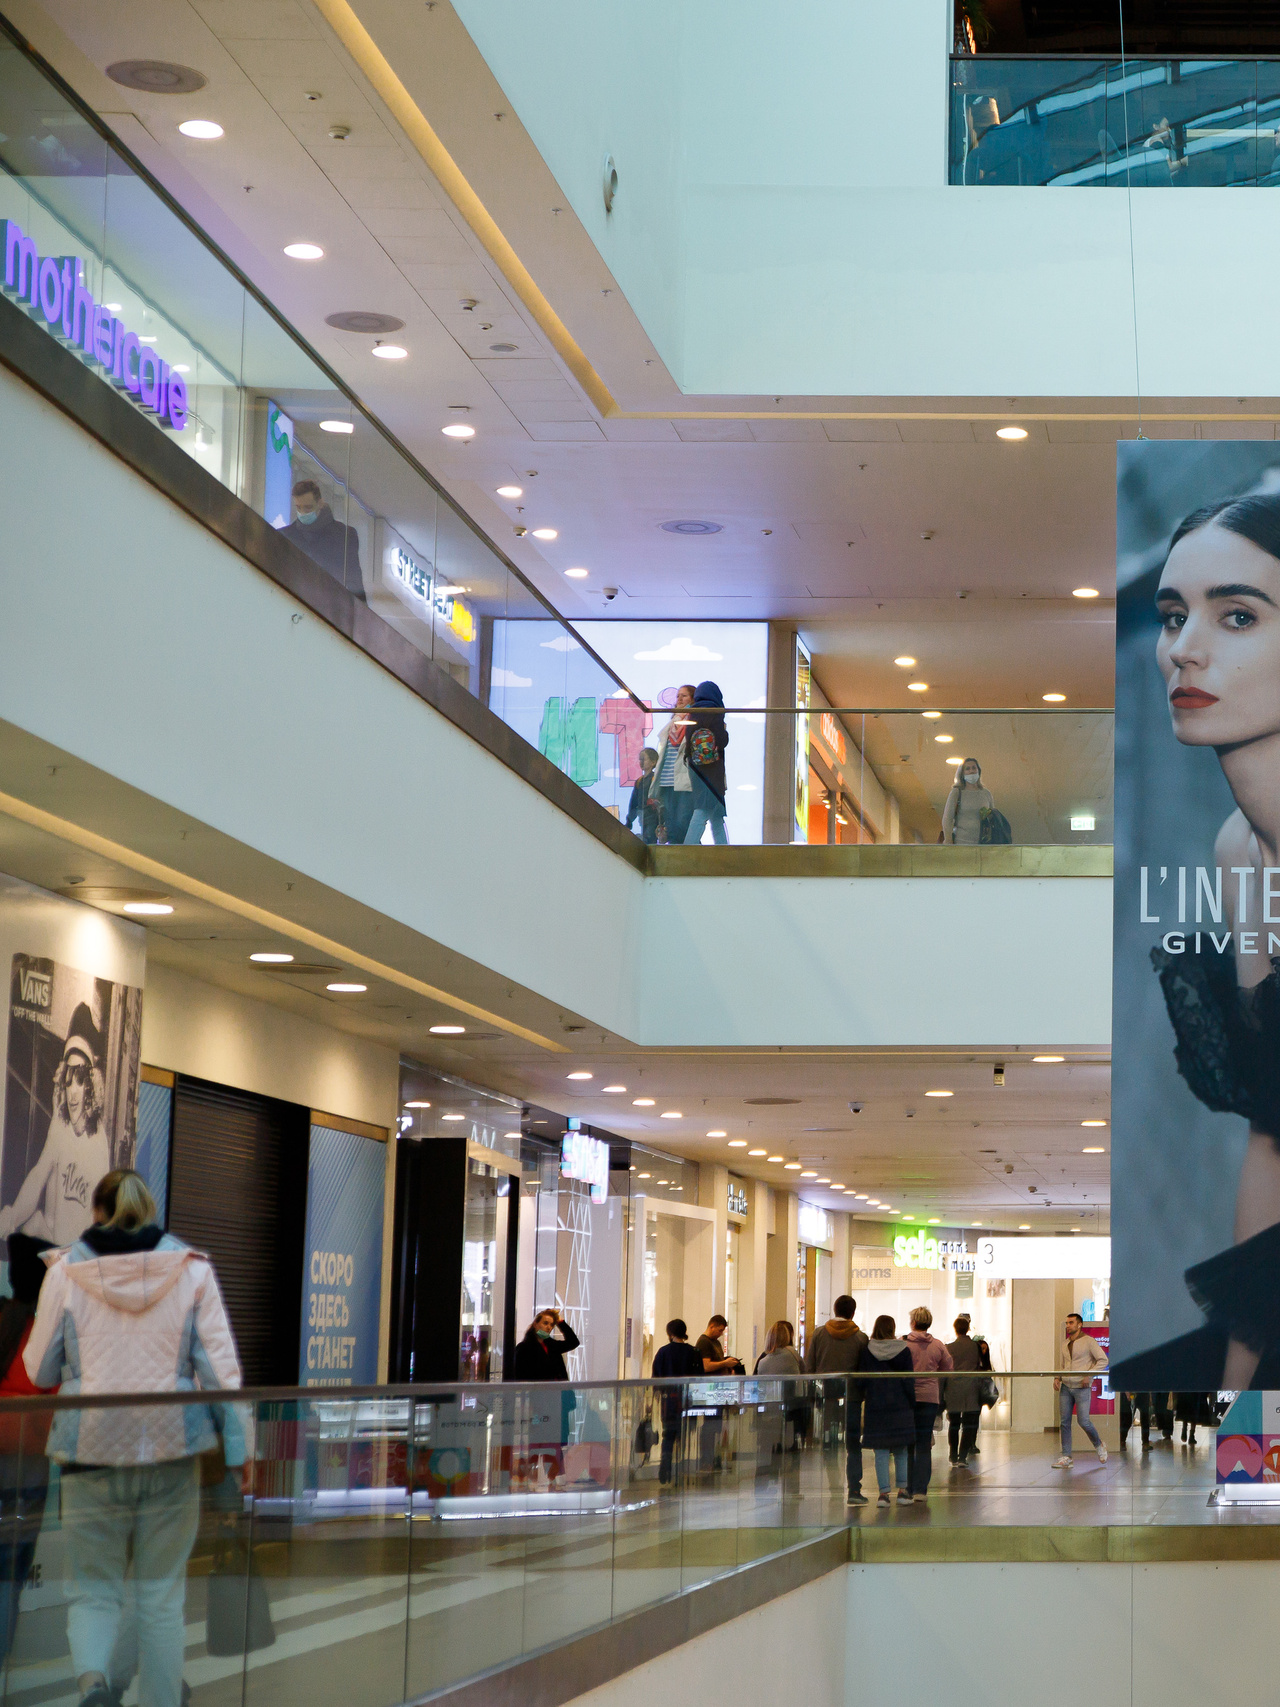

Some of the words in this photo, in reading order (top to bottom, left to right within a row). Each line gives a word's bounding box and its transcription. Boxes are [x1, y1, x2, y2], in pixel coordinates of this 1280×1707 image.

[5, 219, 188, 431] mothercare
[20, 967, 50, 1007] VANS
[310, 1250, 354, 1287] СКОРО
[894, 1230, 938, 1269] sela
[984, 1243, 994, 1264] 3
[308, 1293, 350, 1333] ЗДЕСЬ
[307, 1335, 356, 1370] СТАНЕТ
